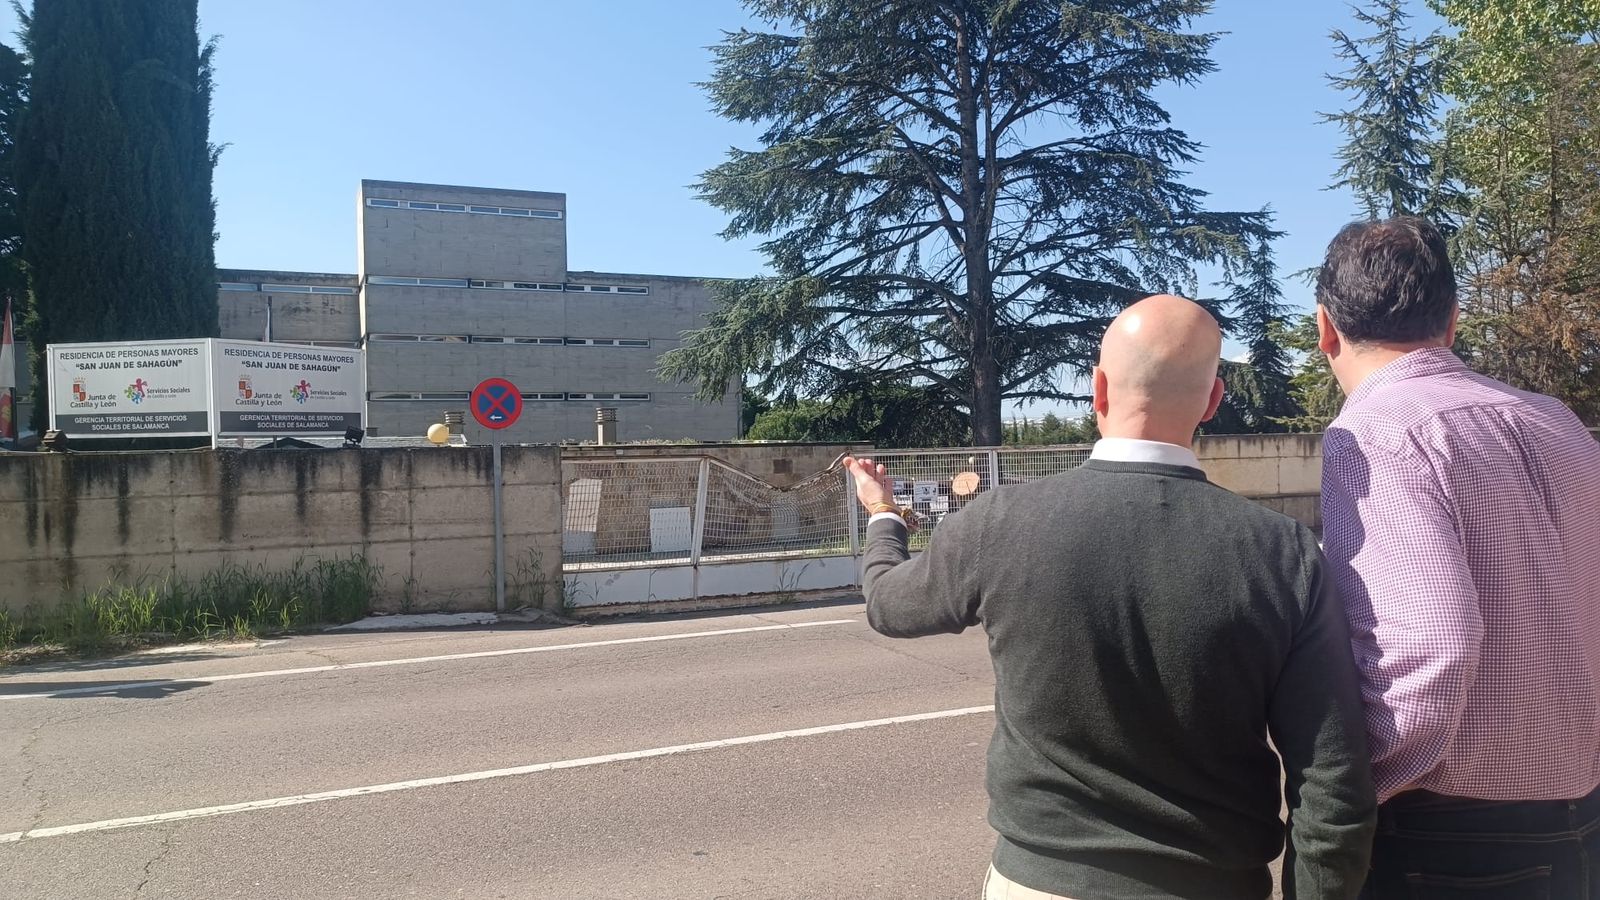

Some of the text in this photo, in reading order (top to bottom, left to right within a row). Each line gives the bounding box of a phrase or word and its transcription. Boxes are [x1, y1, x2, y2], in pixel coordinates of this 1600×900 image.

[118, 349, 159, 357] PERSONAS
[162, 348, 198, 356] MAYORES
[224, 349, 270, 358] RESIDENCIA
[284, 353, 321, 361] PERSONAS
[323, 355, 354, 363] MAYORES
